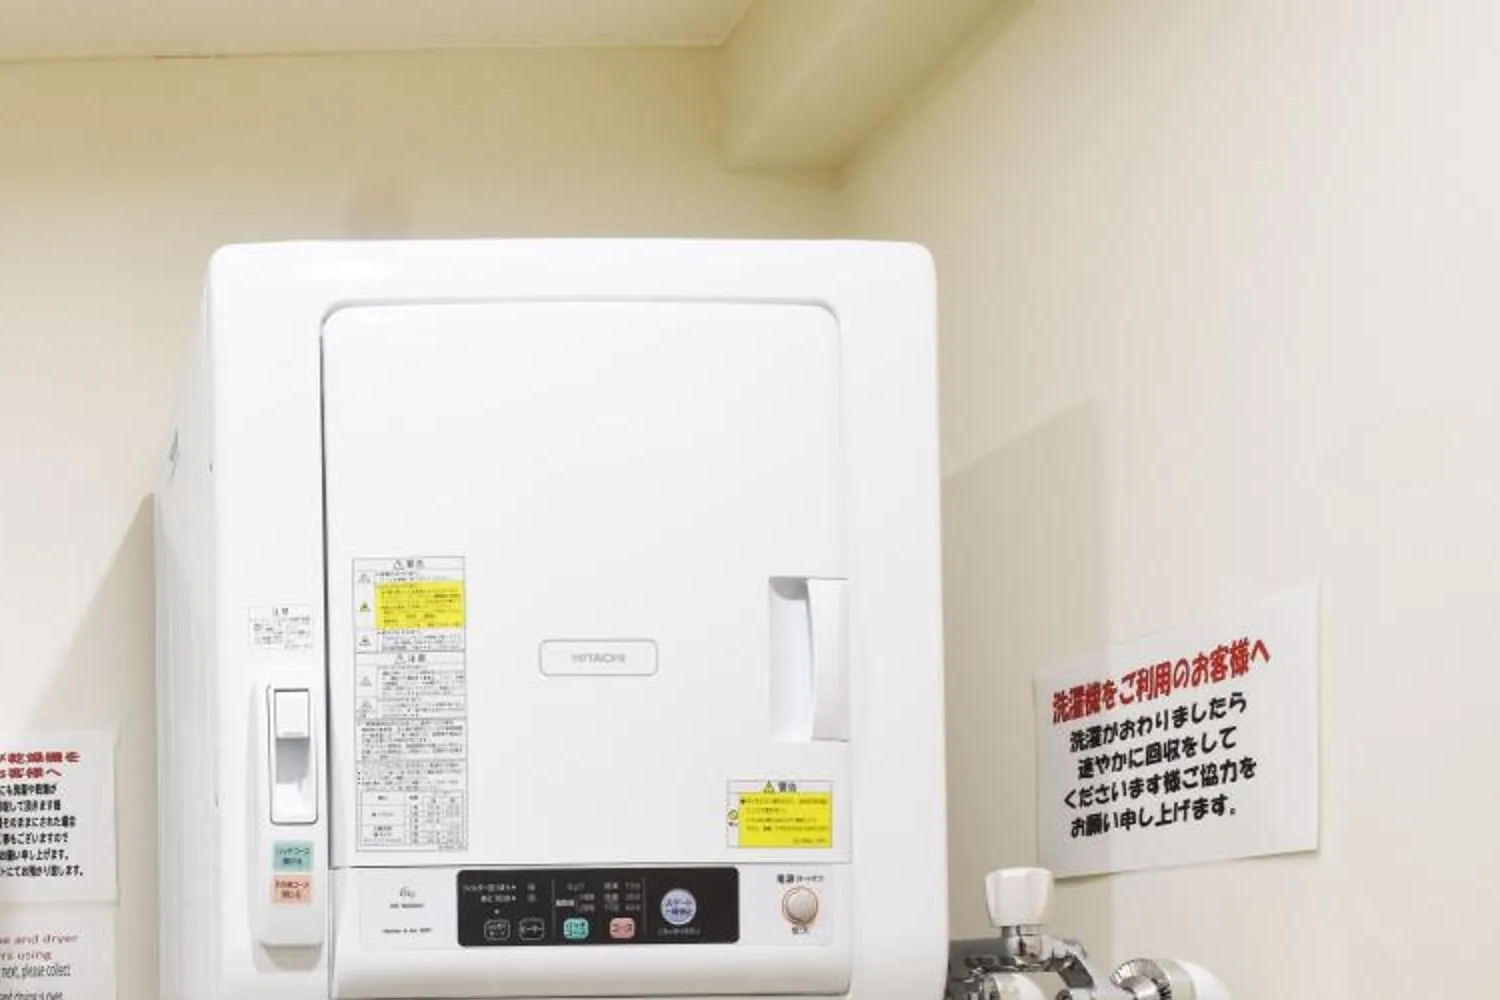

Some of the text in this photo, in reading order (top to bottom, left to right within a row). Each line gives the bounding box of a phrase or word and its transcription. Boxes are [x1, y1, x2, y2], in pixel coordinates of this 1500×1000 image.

[1053, 636, 1271, 723] 洗濯機をご利用のお客様へ
[1069, 690, 1248, 752] 洗濯がおわりましたら
[1077, 724, 1238, 780] 速やかに回収をして
[1063, 756, 1258, 810] くださいます様ご協力を
[1070, 793, 1237, 839] お願い申し上げます。
[13, 934, 39, 944] and
